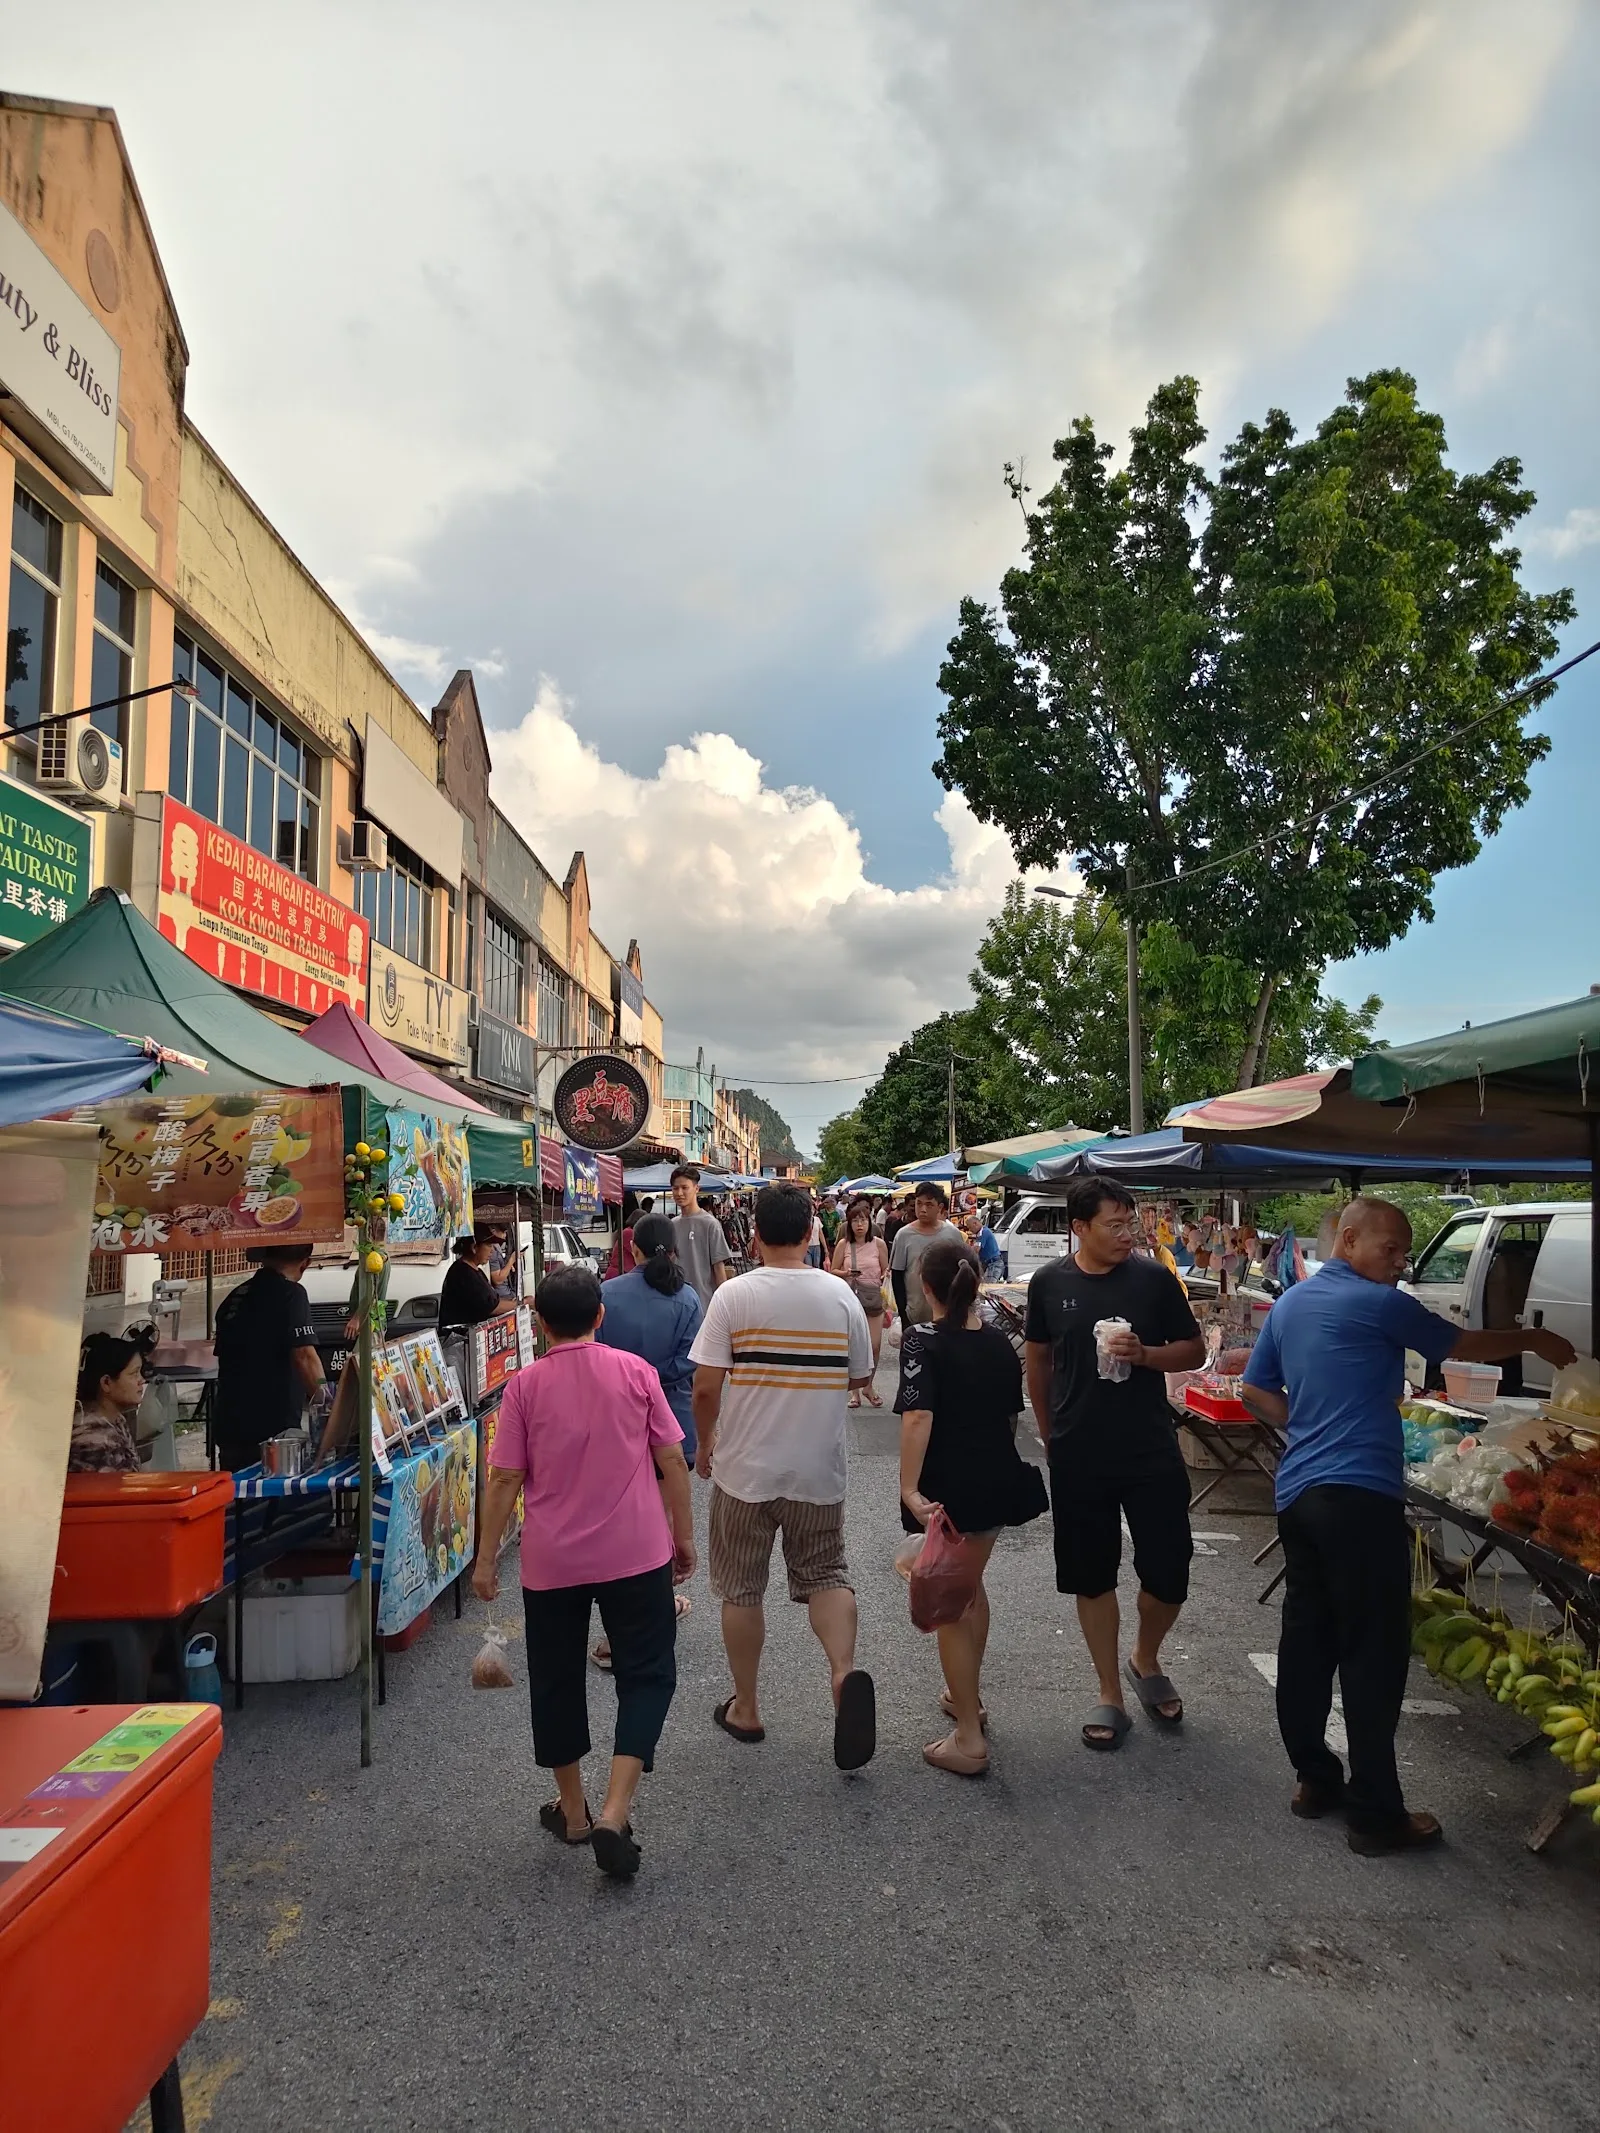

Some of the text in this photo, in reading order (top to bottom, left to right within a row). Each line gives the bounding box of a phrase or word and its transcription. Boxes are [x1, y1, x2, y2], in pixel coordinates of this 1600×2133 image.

[43, 323, 61, 361] &
[65, 344, 112, 416] Bliss
[21, 821, 78, 867] TASTE
[0, 878, 68, 924] 里茶铺
[207, 829, 346, 933] KEDAI BARANGAN ELEKTRIK
[199, 911, 269, 955] Lampu Penjimatan Tenaga
[219, 895, 246, 927] KOK
[248, 909, 291, 948] KWONG
[293, 932, 336, 969] TRADING
[304, 960, 346, 989] Energy Saving Lamp
[424, 976, 453, 1033] TYT
[406, 1018, 466, 1056] Take Your Time Coffee
[501, 1028, 522, 1073] KNK
[570, 1069, 635, 1124] 黑豆腐
[330, 1360, 346, 1370] 96
